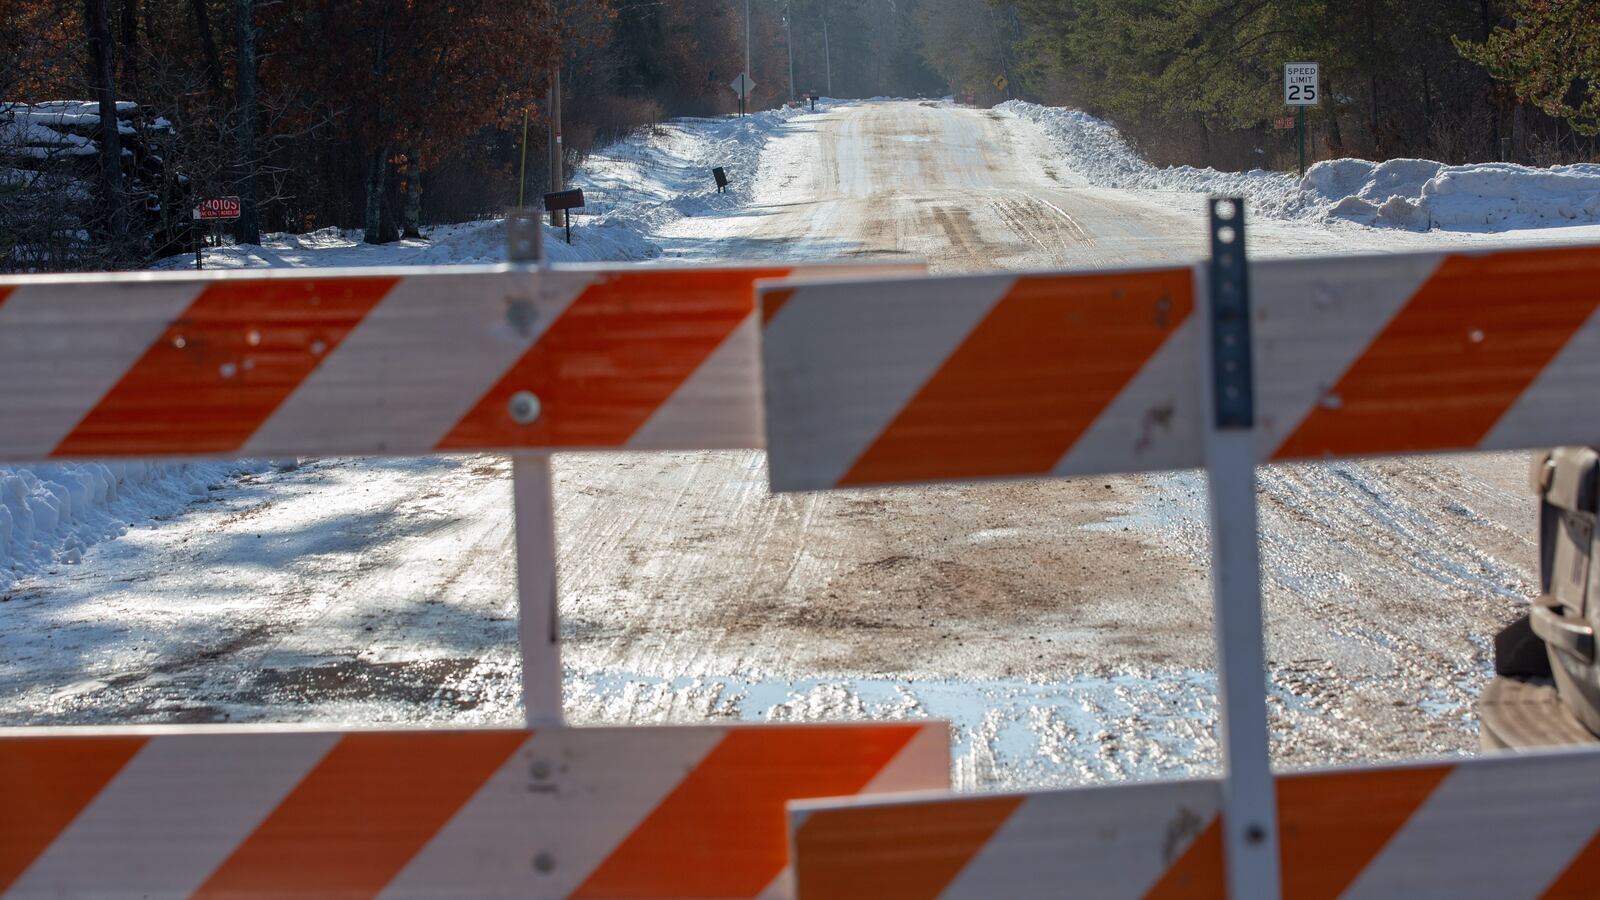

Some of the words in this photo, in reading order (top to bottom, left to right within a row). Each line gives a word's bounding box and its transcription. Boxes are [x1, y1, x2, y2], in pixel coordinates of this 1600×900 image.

[1287, 67, 1316, 75] SPEED
[1290, 76, 1313, 84] LIMIT
[1288, 85, 1316, 100] 25
